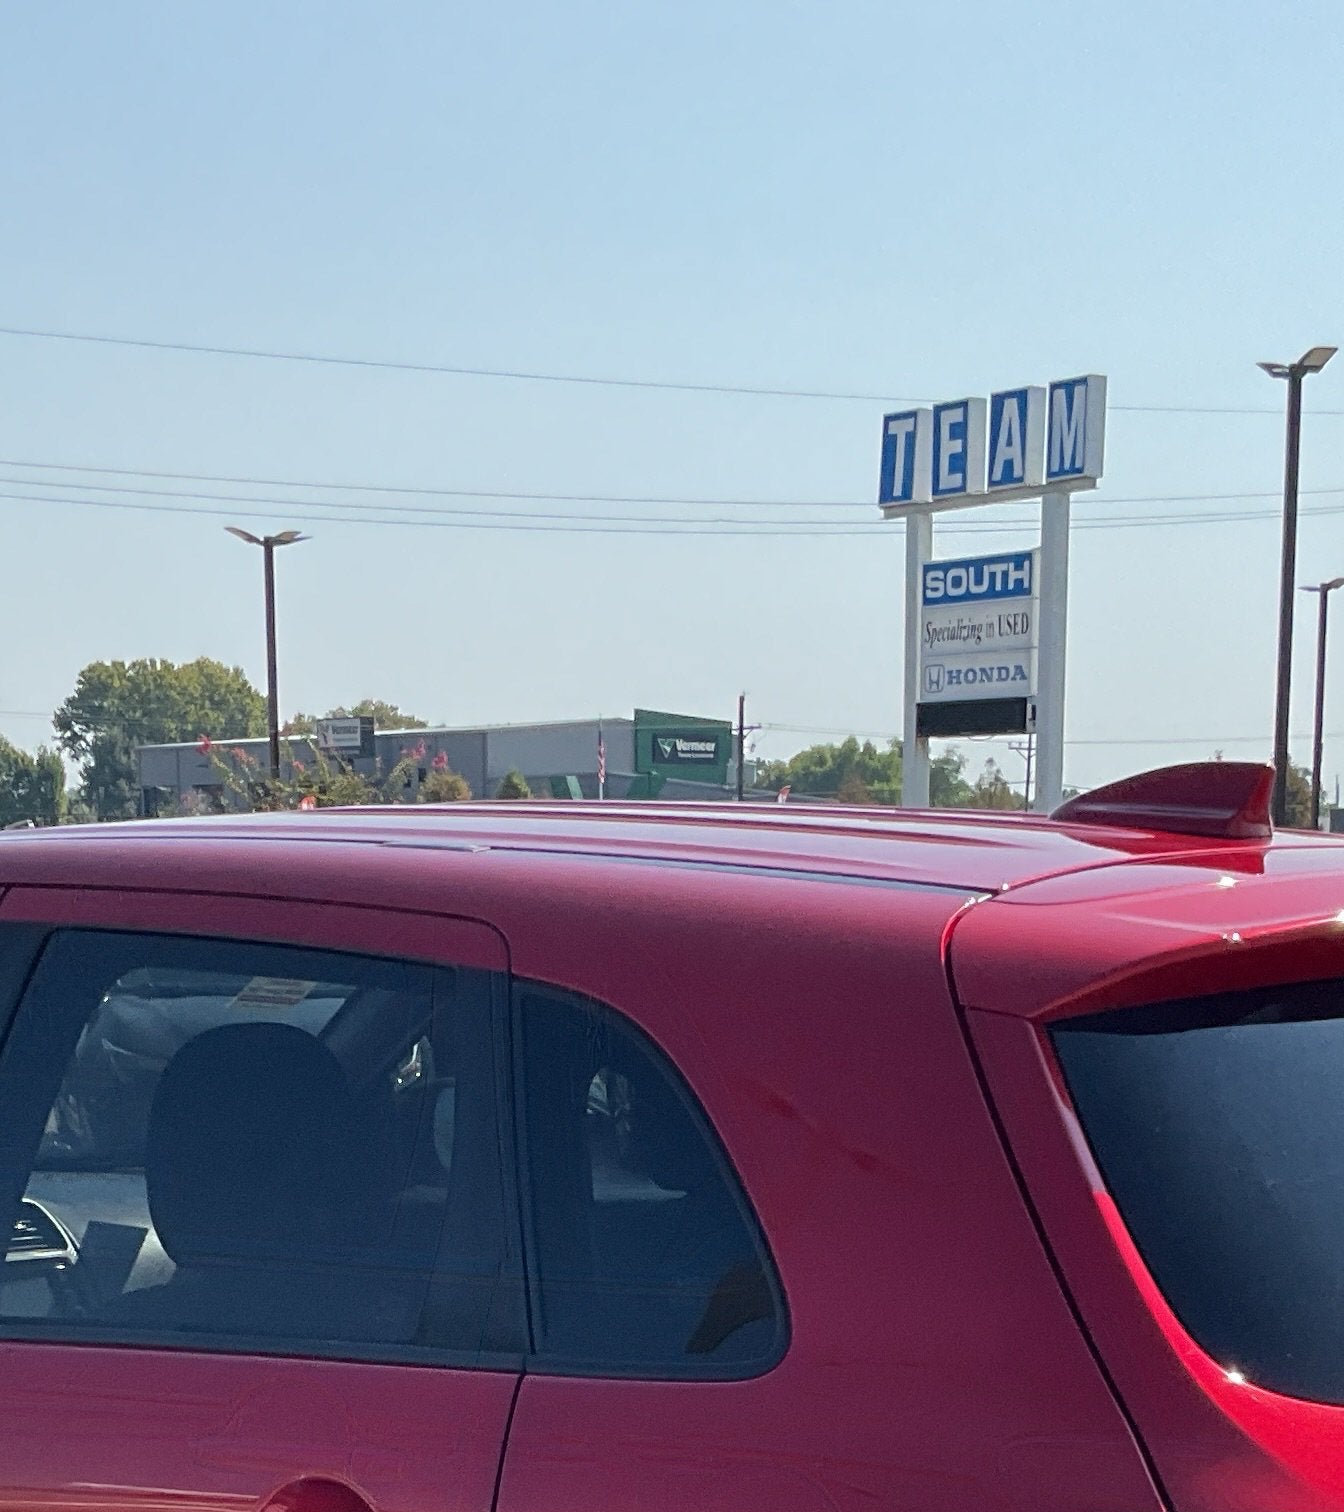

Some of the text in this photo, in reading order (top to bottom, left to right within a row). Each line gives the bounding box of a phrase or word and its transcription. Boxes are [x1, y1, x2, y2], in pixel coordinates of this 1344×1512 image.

[887, 385, 1087, 497] TEAM
[925, 560, 1030, 598] SOUTH
[924, 612, 1030, 648] Specializing in USED
[946, 664, 1028, 686] HONDA
